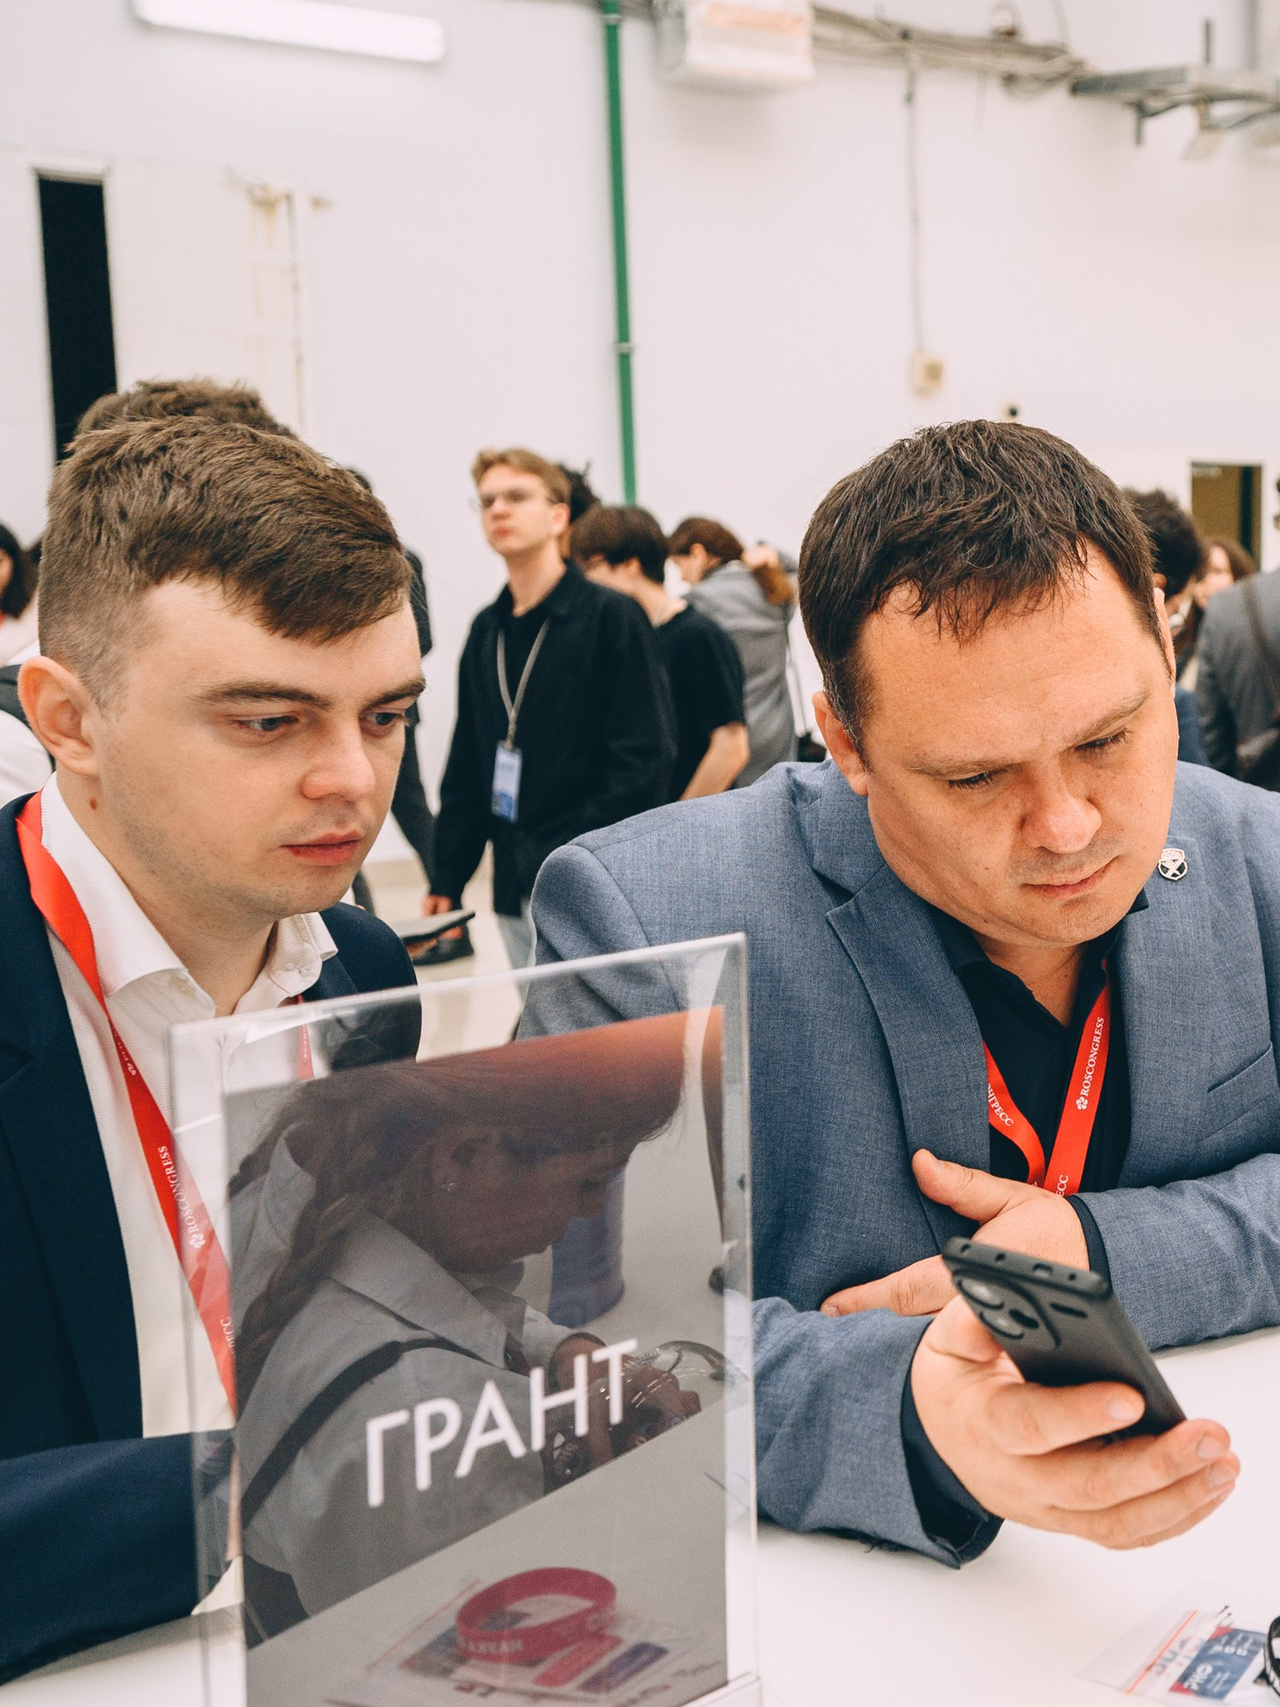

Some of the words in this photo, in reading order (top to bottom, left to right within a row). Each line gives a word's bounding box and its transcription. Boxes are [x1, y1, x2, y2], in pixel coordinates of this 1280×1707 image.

[1080, 1016, 1105, 1097] ROSCONGRESS
[157, 1145, 198, 1234] ROSCONGRESS
[364, 1337, 639, 1509] ГРАНТ
